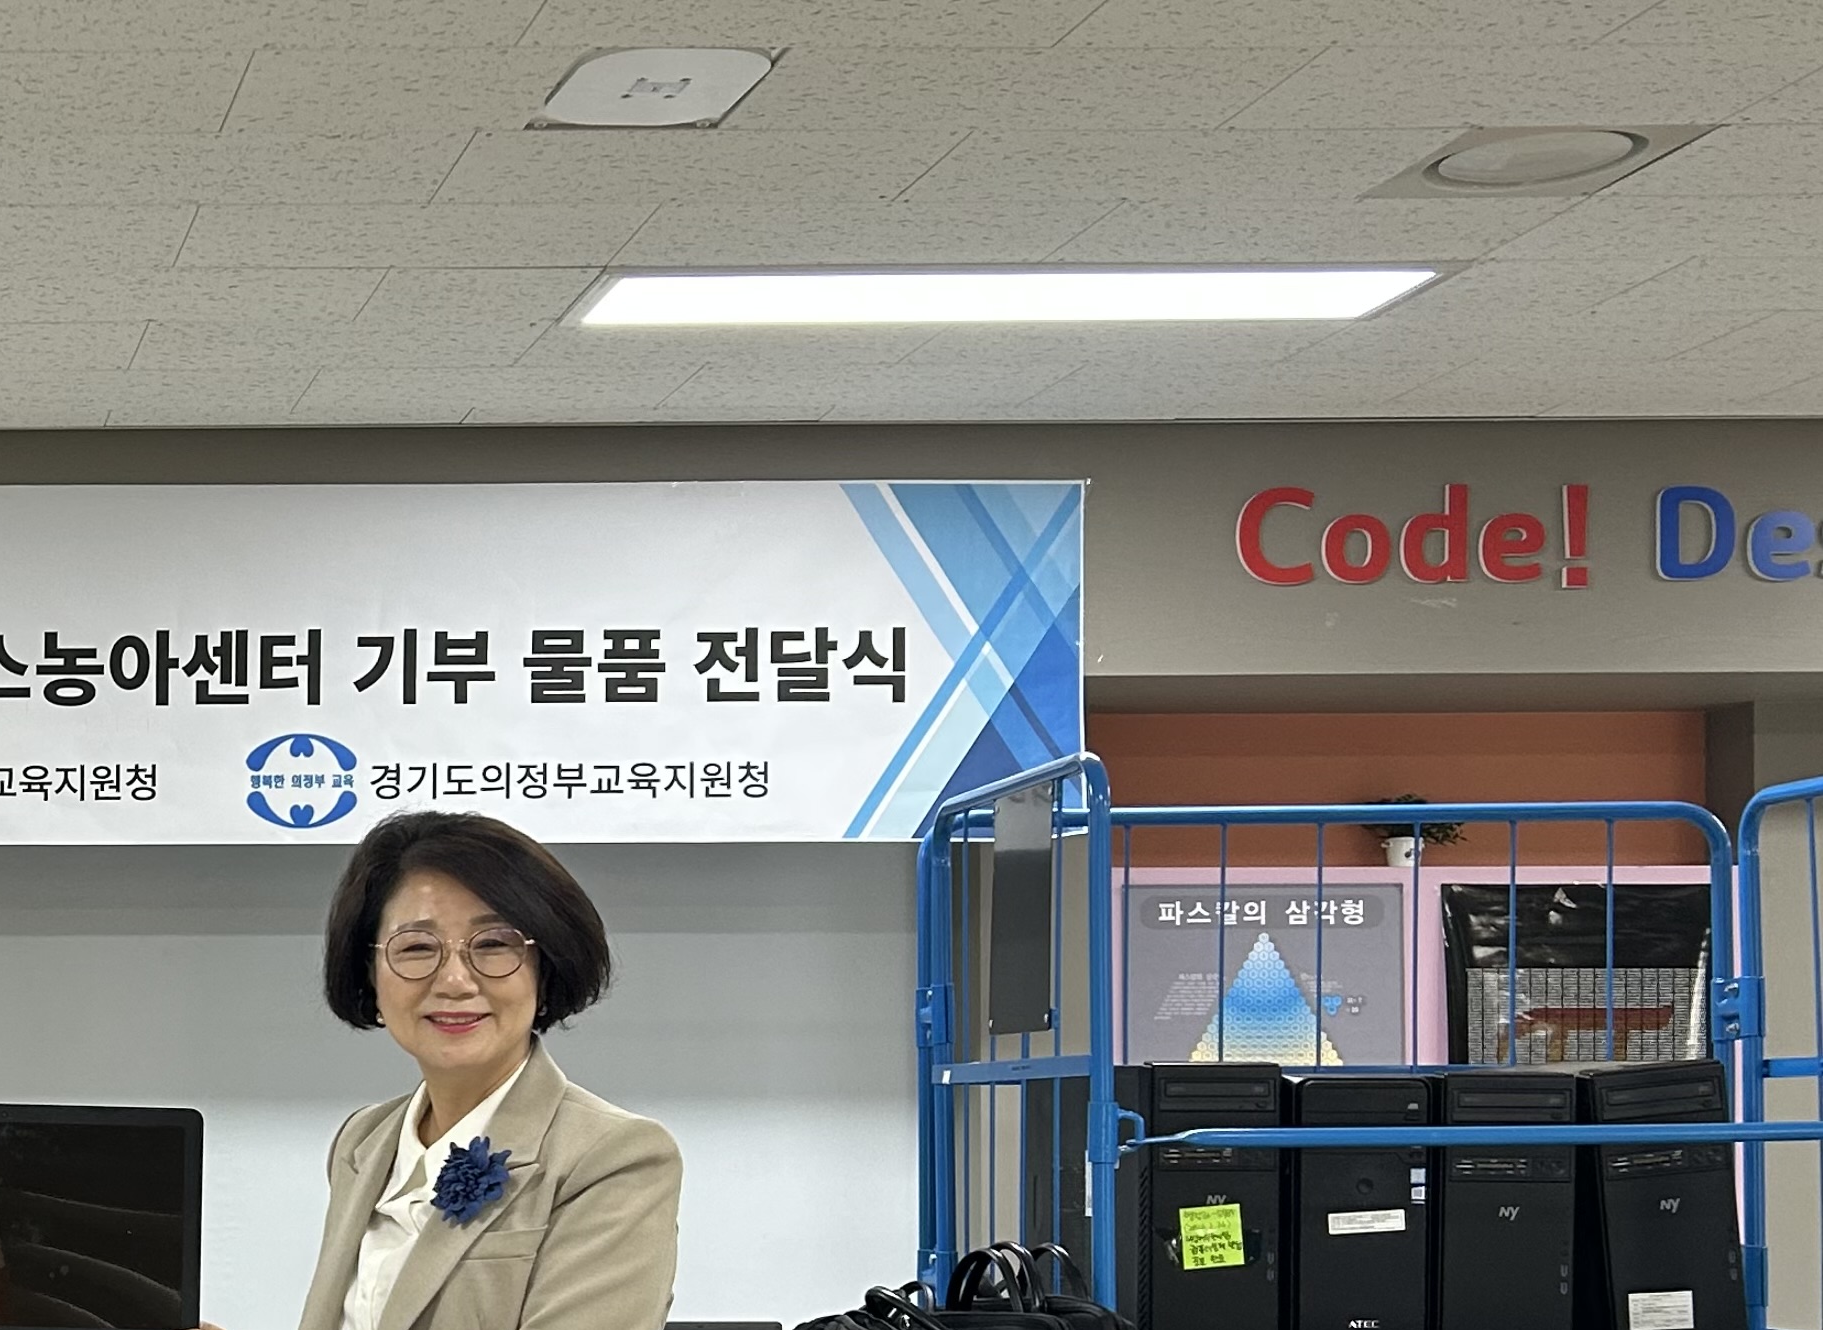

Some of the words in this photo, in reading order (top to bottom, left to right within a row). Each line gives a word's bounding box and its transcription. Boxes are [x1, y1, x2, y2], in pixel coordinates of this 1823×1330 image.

[1235, 483, 1590, 589] Code!
[1656, 484, 1823, 582] De
[352, 628, 496, 704] 기부
[522, 629, 666, 704] 물품
[693, 627, 906, 704] 전달식
[291, 774, 325, 789] 의정부
[331, 774, 354, 788] 교육
[369, 761, 769, 800] 경기도의정부교육지원청
[1158, 899, 1267, 925] 파스칼의
[1285, 899, 1365, 925] 삼각형
